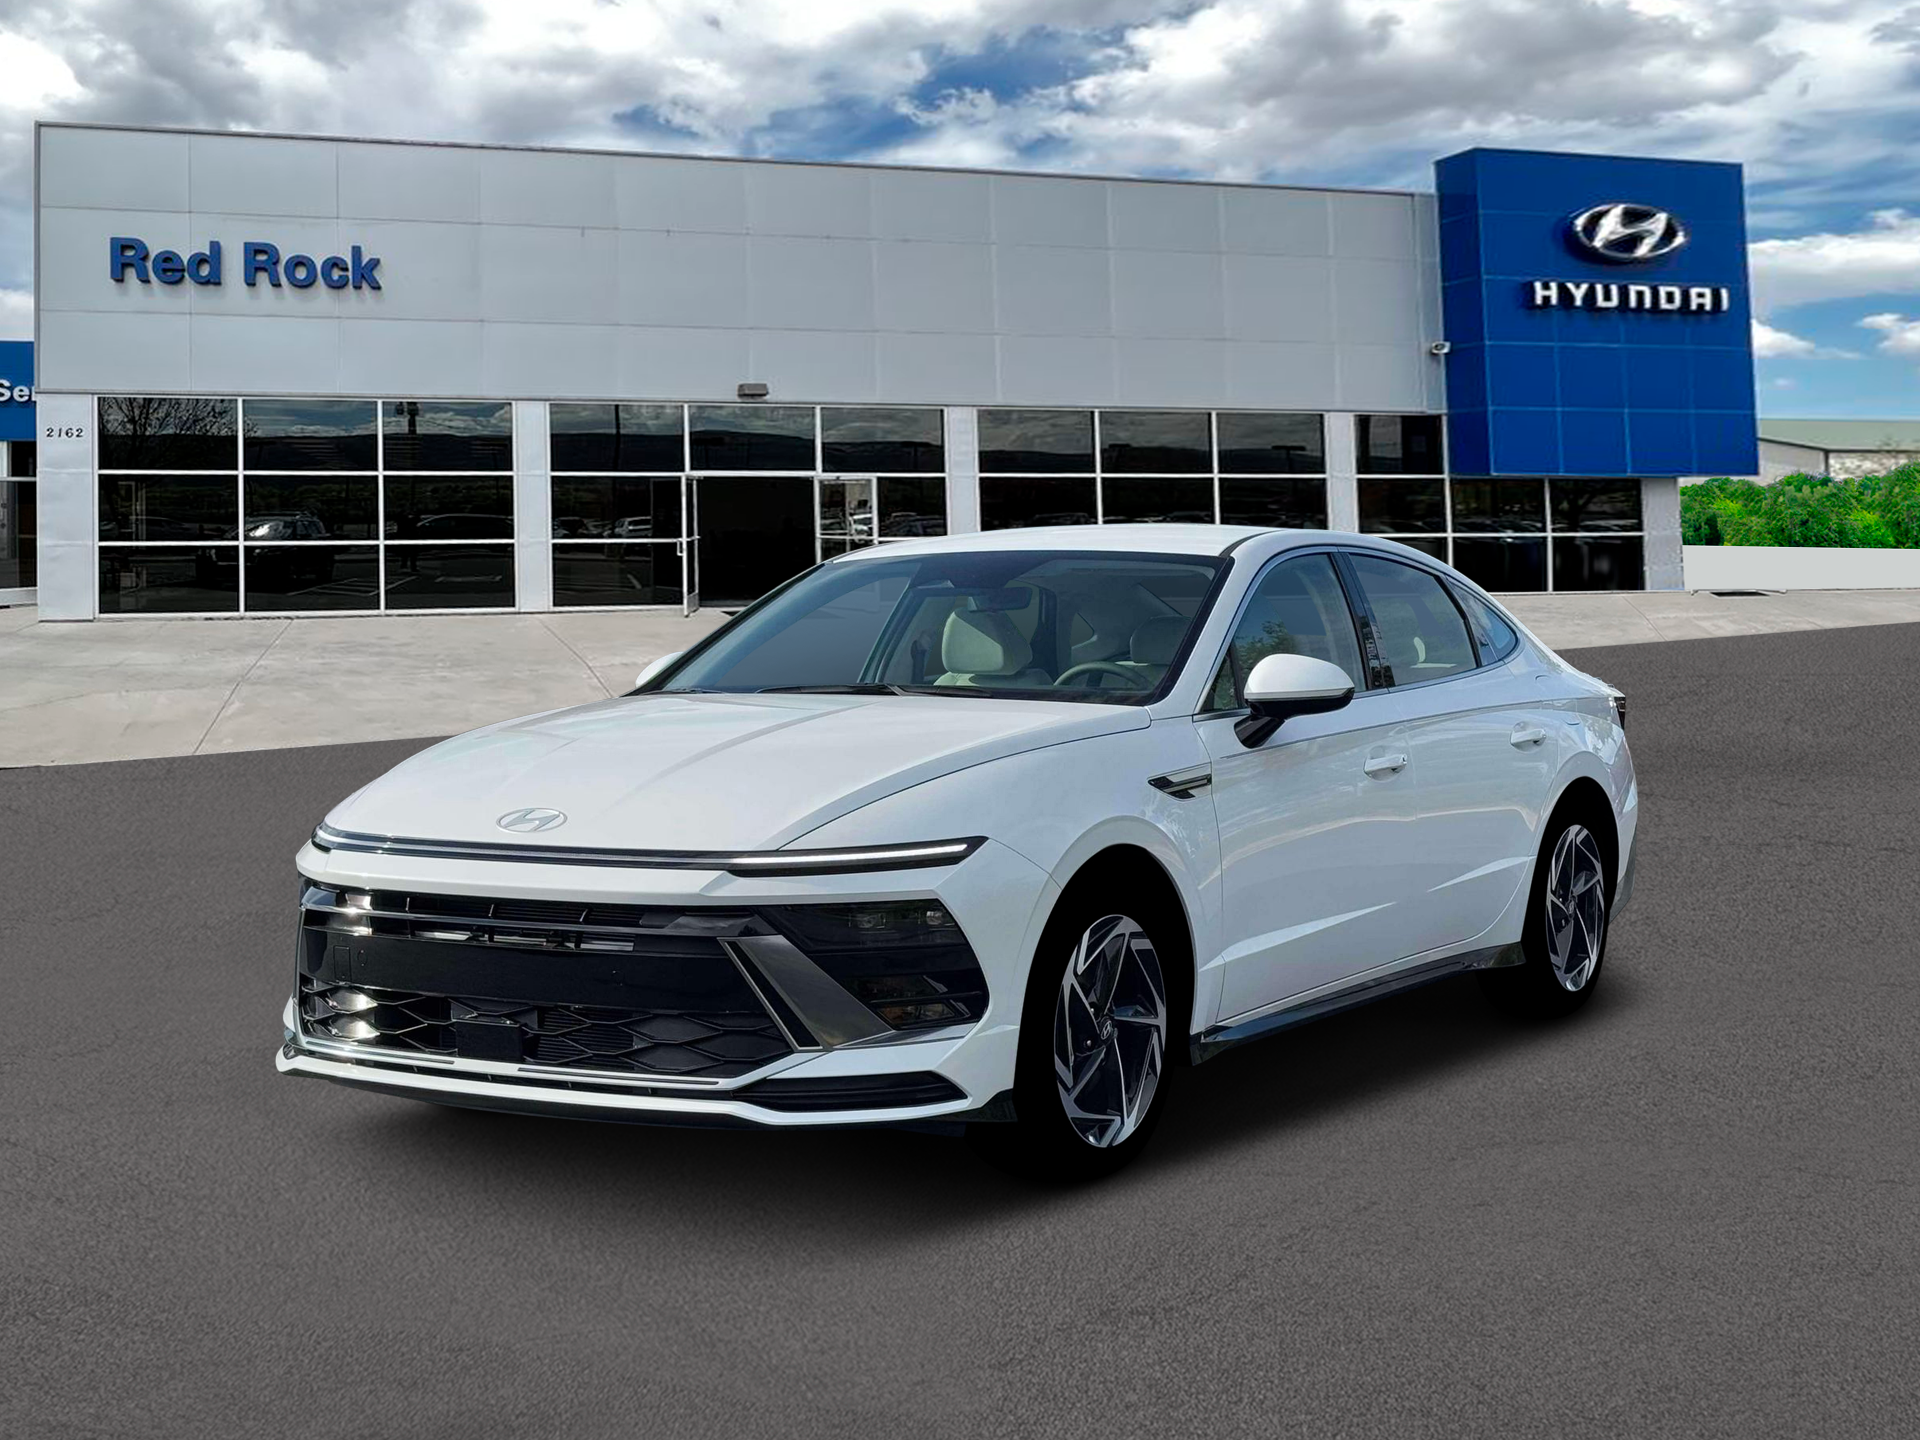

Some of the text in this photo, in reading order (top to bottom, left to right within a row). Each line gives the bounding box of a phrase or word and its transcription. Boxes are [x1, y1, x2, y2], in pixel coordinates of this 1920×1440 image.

[110, 237, 381, 290] Red Rock
[1533, 280, 1730, 311] HYUNDAI
[46, 427, 84, 438] 2162
